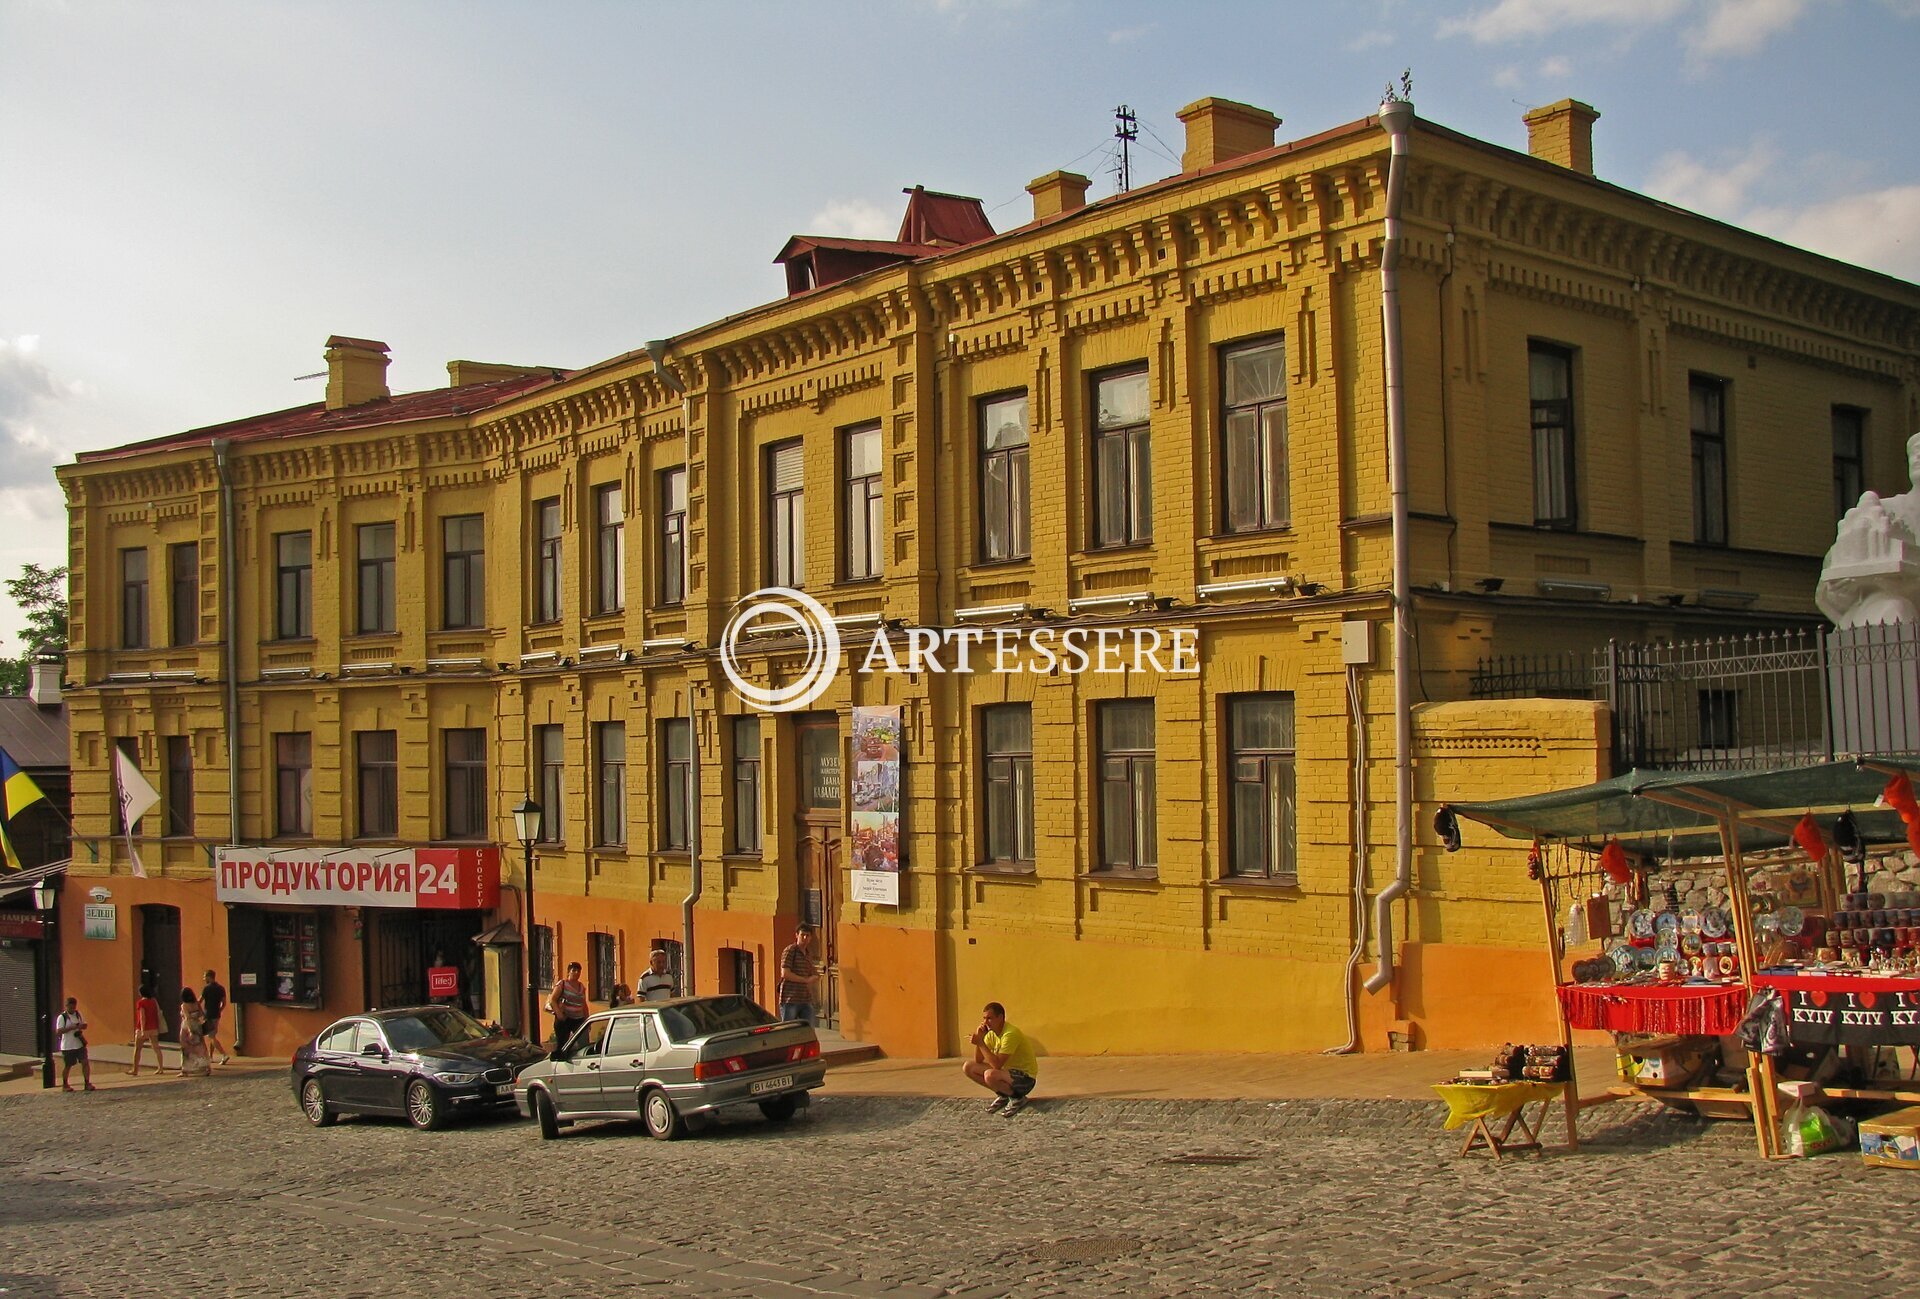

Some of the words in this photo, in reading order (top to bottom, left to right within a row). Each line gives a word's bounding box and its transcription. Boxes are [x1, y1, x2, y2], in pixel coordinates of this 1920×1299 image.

[221, 861, 411, 895] ПРОДУКТОРИЯ
[418, 863, 458, 895] 24
[1799, 991, 1807, 1005] I
[1846, 992, 1856, 1007] I
[1896, 992, 1906, 1007] I
[1792, 1008, 1833, 1024] KYIV
[1841, 1010, 1883, 1025] KYIV
[1891, 1010, 1920, 1025] KY
